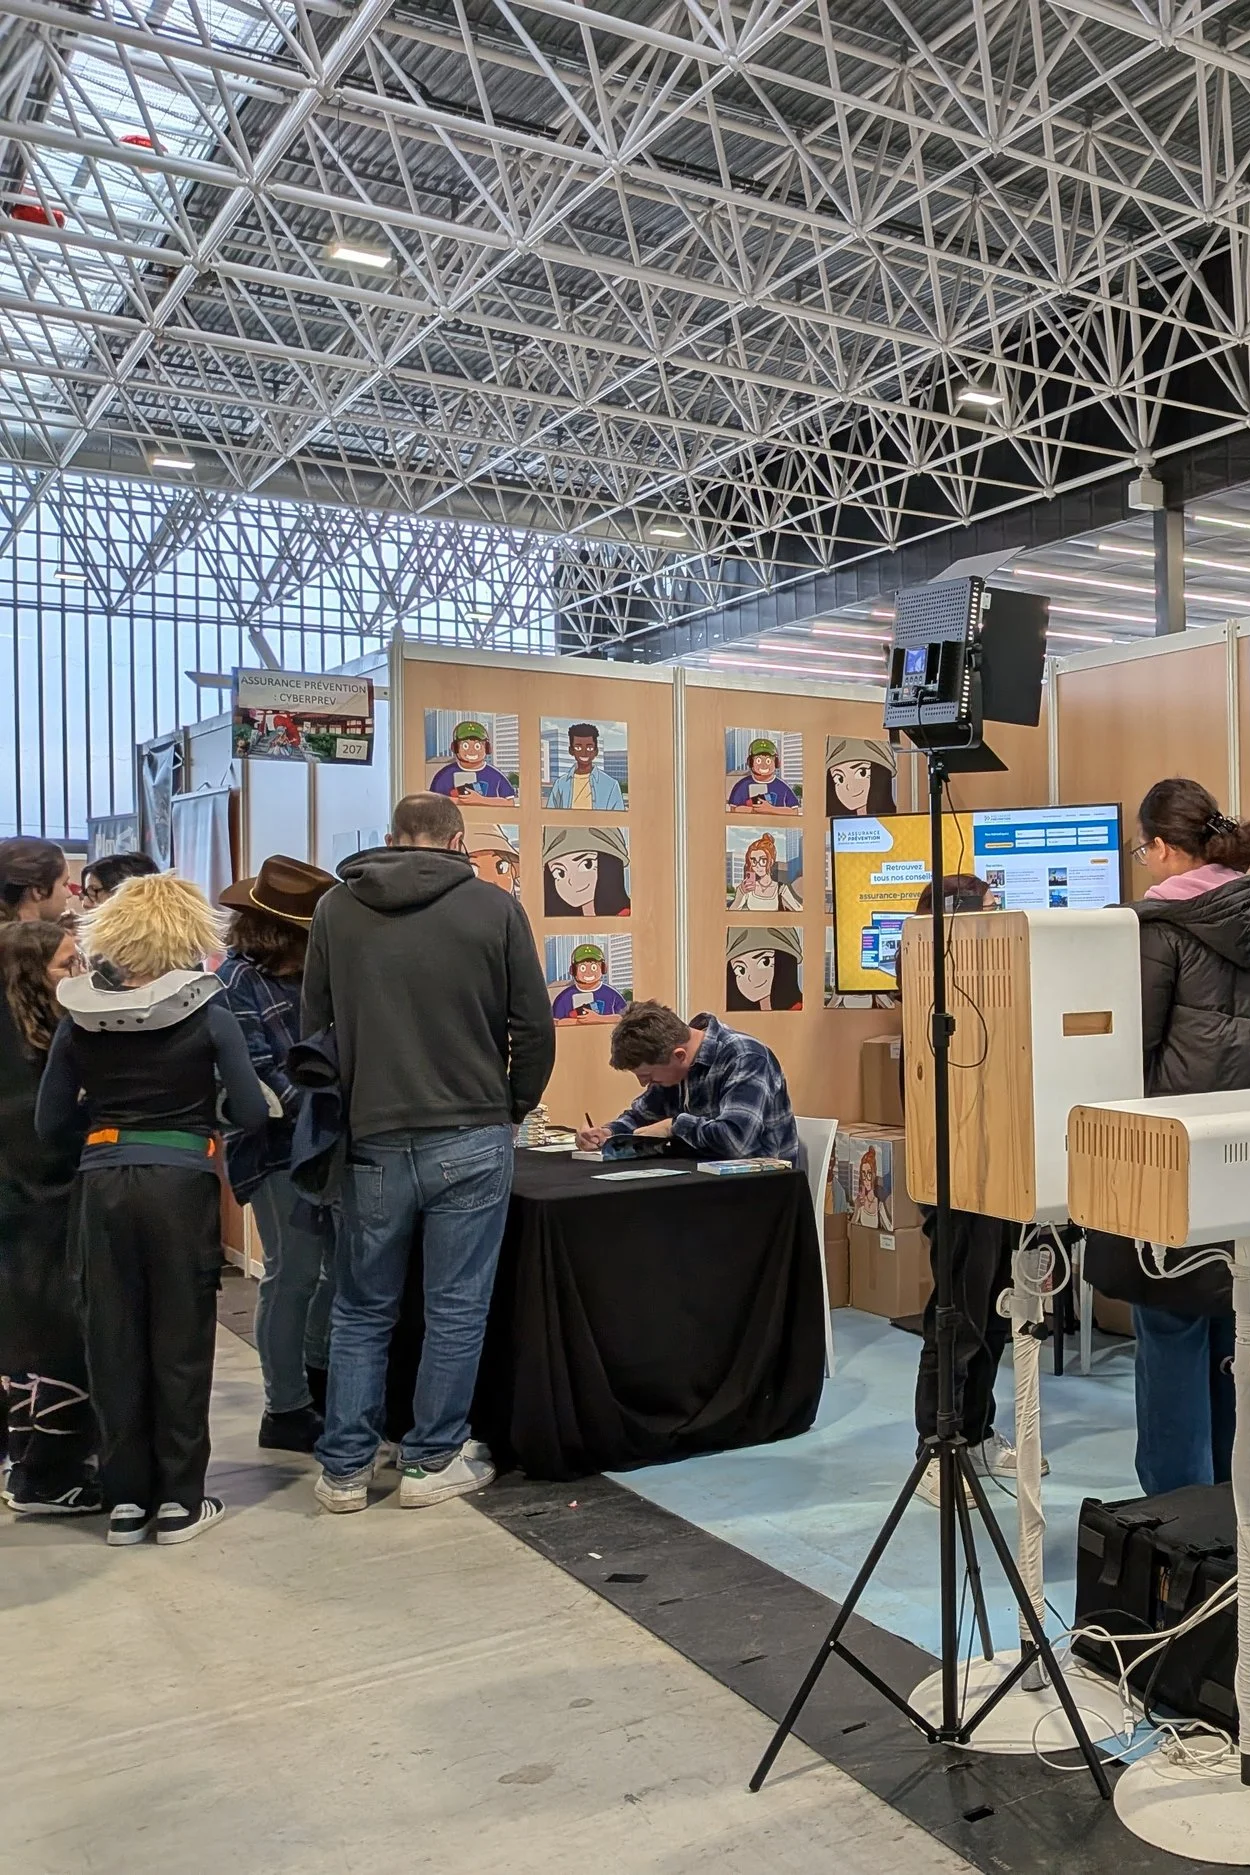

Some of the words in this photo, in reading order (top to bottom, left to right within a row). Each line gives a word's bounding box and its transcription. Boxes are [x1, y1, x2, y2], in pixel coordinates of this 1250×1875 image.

[241, 676, 301, 689] ASSURANCE
[304, 680, 367, 694] PRÉVENTION
[279, 693, 337, 706] CYBERPREV
[342, 743, 363, 756] 207
[847, 834, 881, 842] PRÉVENTION
[885, 863, 923, 872] Retrouvez
[890, 874, 905, 882] nos
[859, 891, 922, 900] assurance-preve
